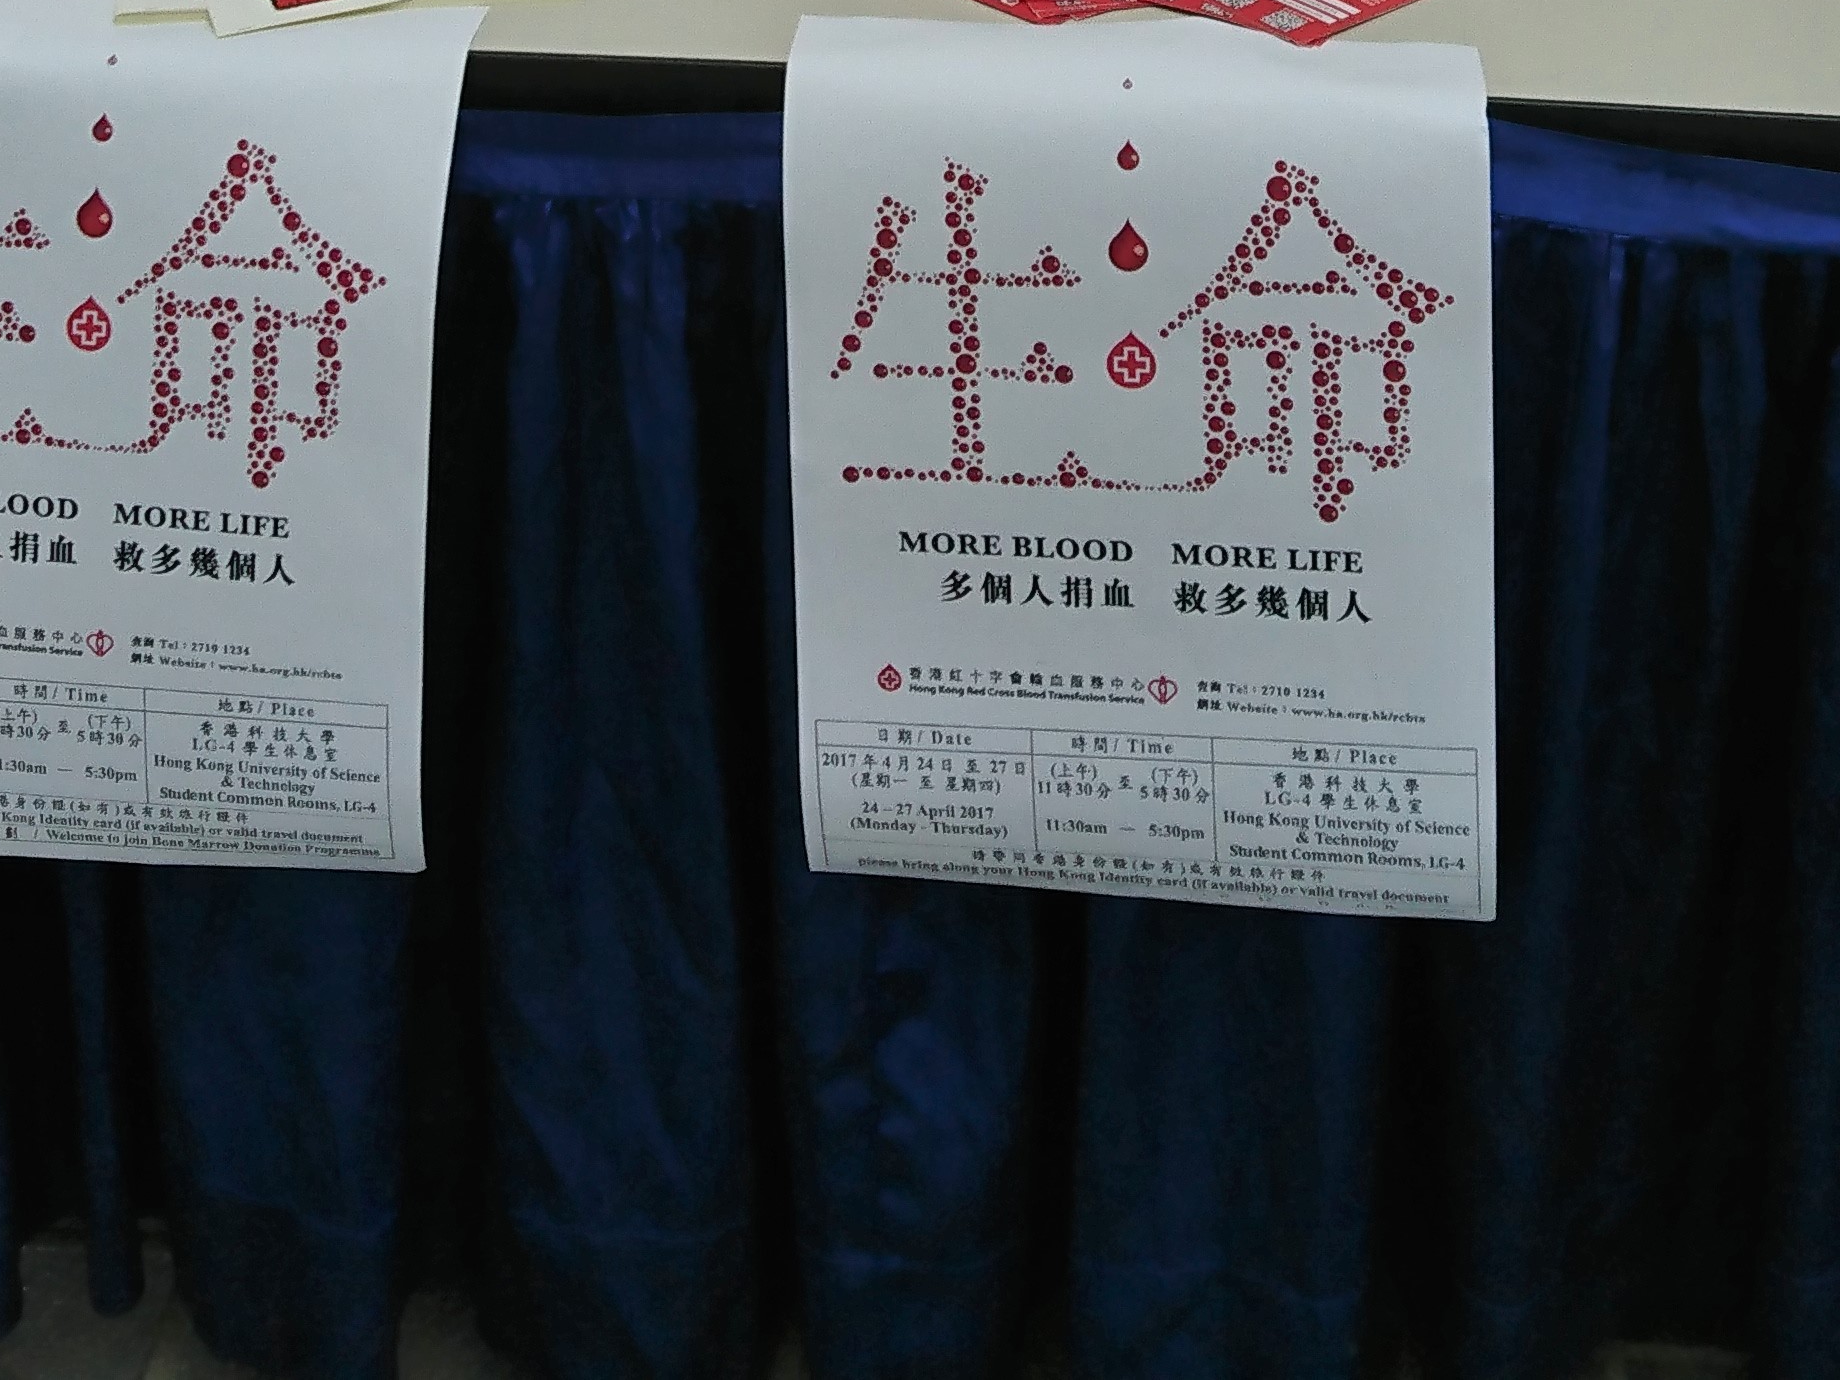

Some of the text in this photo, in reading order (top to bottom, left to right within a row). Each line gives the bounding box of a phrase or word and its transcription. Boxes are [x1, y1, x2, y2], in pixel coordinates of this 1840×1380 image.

[830, 155, 1457, 523] 生命
[114, 504, 209, 531] MORE
[221, 513, 289, 538] LIFE
[113, 541, 295, 585] 救多幾個人
[899, 531, 1362, 574] MORE BLOOD MORE LIFE
[942, 570, 1370, 623] 多個人捐血 救多幾個人
[1047, 819, 1107, 834] 11:30am
[1149, 824, 1204, 841] 5:30pm
[1222, 810, 1471, 841] Hong Kong University of Science
[1295, 832, 1399, 852] & Technology
[1229, 844, 1466, 871] Student Common Rooms, LG-4
